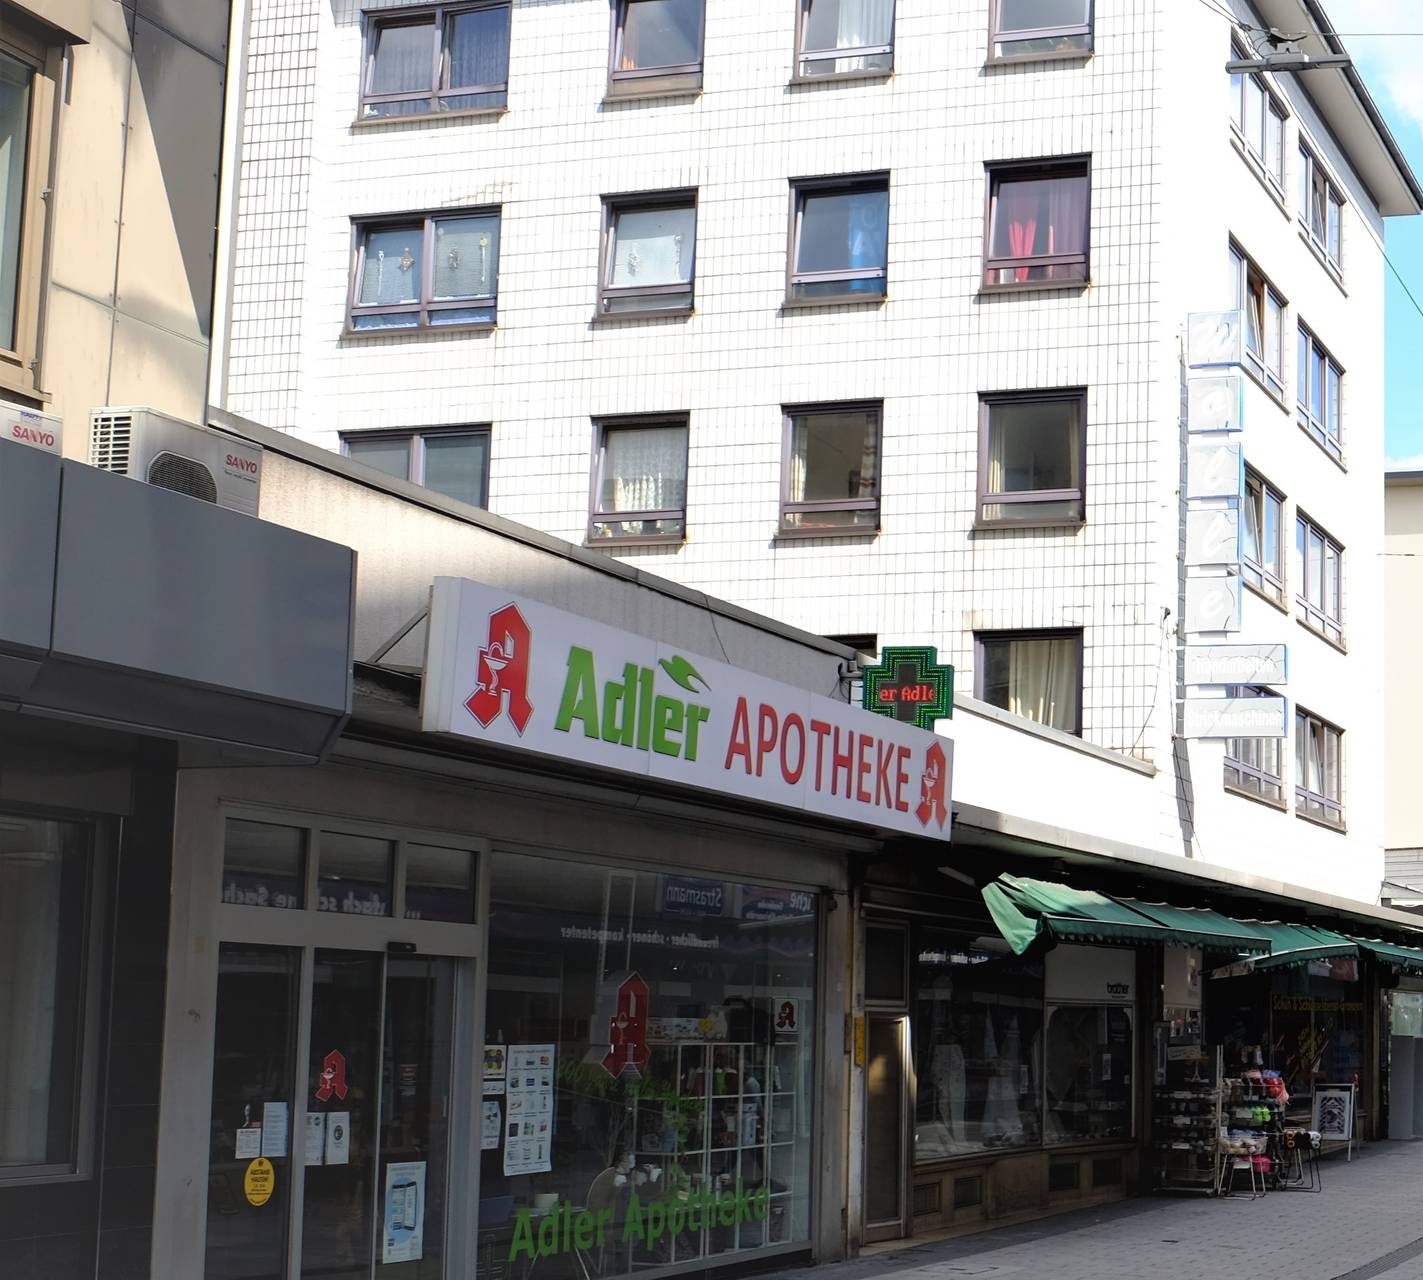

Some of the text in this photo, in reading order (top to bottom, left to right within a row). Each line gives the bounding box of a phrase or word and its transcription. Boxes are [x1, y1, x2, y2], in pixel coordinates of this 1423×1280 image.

[12, 425, 55, 447] SANYO
[225, 454, 258, 474] SANYO
[555, 645, 711, 761] Adler
[725, 696, 912, 812] APOTHEKE
[509, 1181, 769, 1262] Adler Apotheke
